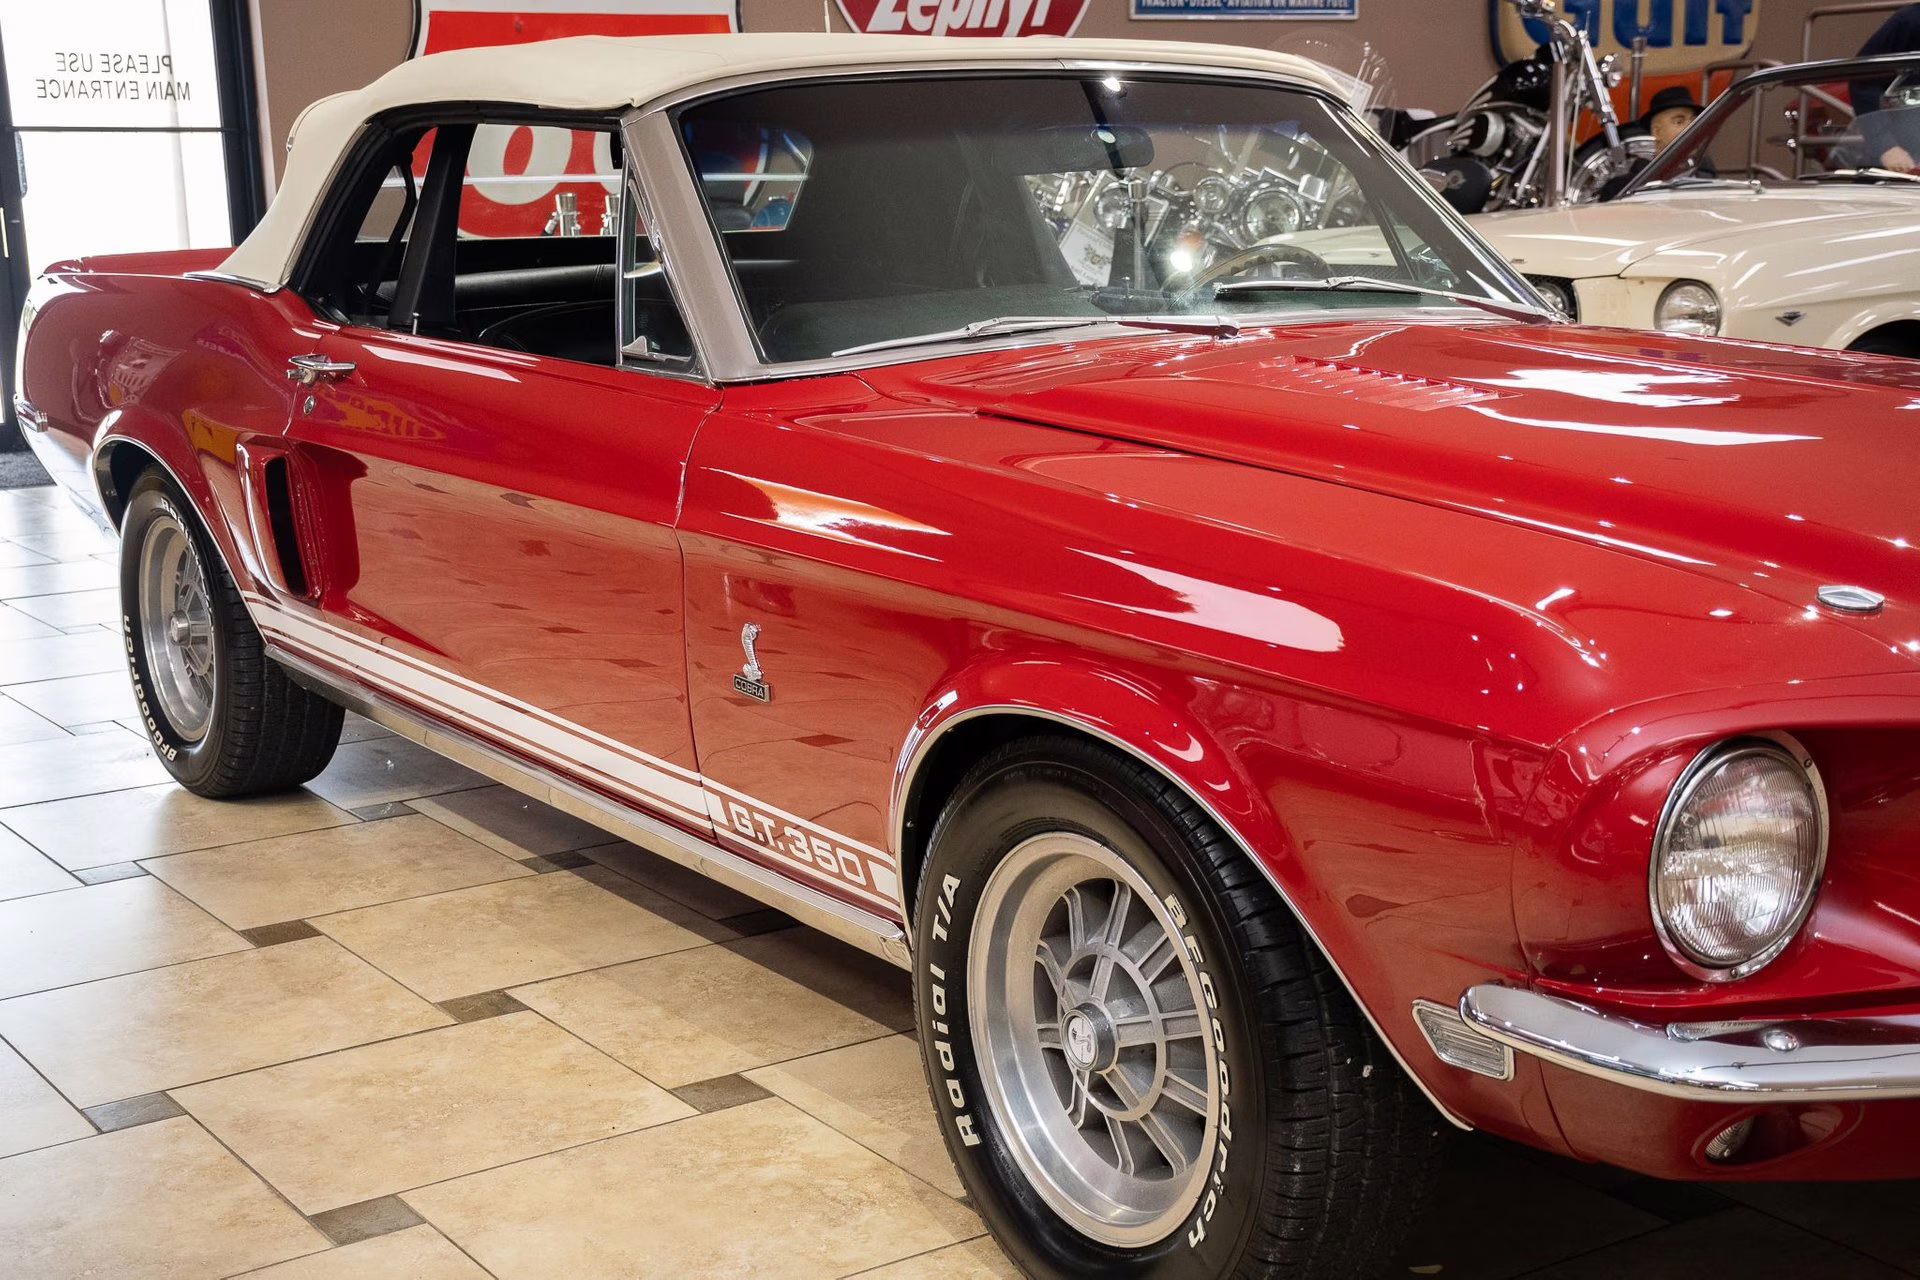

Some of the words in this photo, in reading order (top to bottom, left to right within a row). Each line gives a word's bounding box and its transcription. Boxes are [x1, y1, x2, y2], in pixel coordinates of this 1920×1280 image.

[734, 677, 765, 698] COBRA
[932, 873, 962, 942] T/A
[929, 962, 982, 1147] Radial
